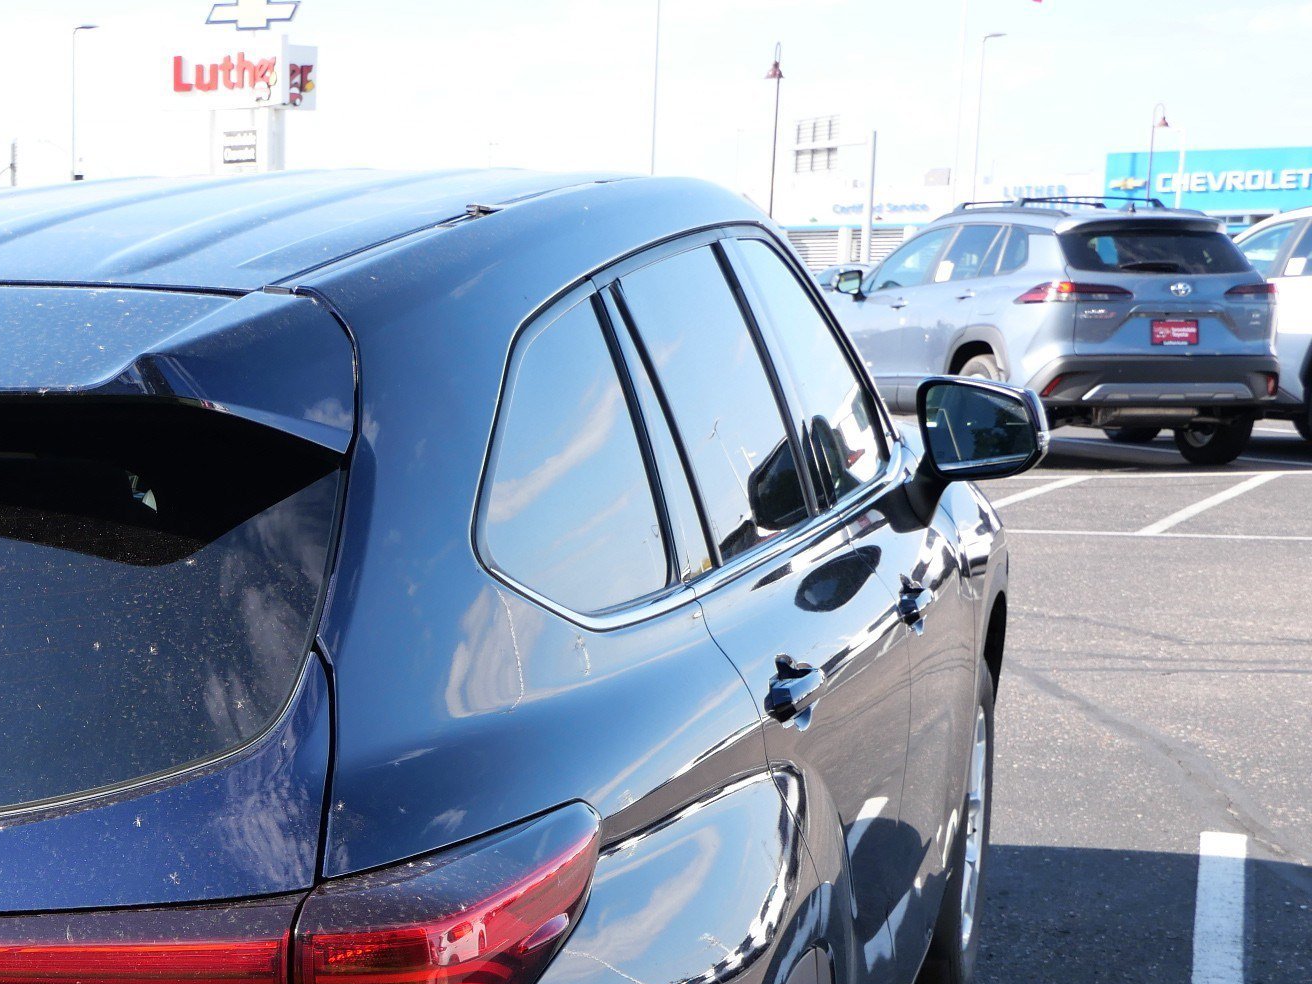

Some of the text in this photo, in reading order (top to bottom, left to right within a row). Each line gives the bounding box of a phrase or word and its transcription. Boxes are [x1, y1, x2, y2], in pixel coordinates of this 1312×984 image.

[173, 51, 277, 93] Luther
[1155, 168, 1312, 193] CHEVROLET
[1003, 185, 1067, 198] LUTHER
[886, 201, 930, 213] Service
